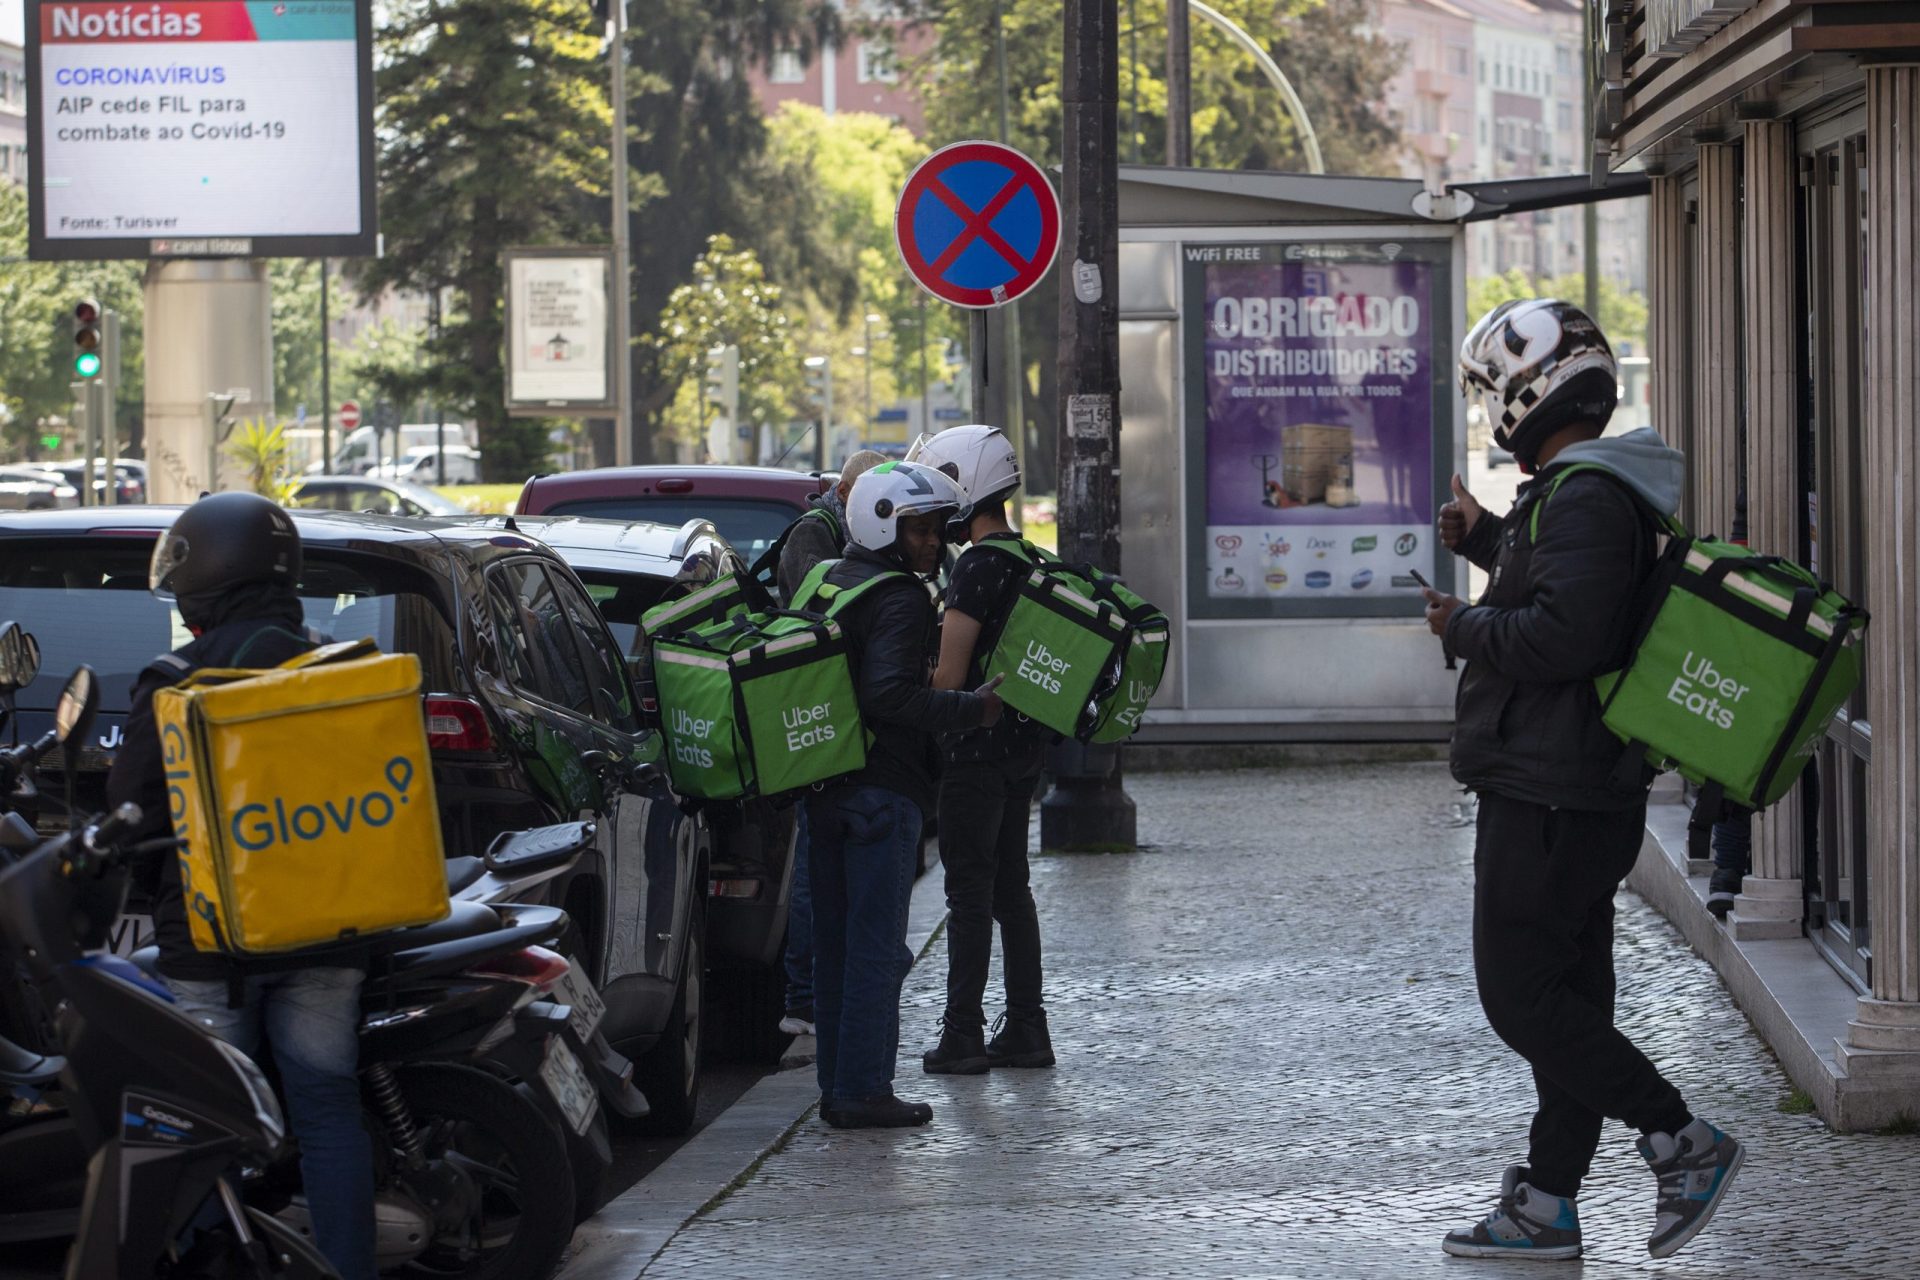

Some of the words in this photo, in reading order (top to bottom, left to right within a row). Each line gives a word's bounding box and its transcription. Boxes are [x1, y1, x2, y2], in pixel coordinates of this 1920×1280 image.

[52, 7, 202, 37] Notícias
[56, 63, 226, 85] CORONAVÍRUS
[57, 97, 94, 114] AIP
[101, 97, 150, 114] cede
[159, 96, 191, 113] FIL
[200, 98, 246, 115] para
[58, 123, 150, 141] combate
[158, 126, 183, 140] ao
[191, 121, 286, 140] Covid-19
[60, 217, 109, 230] Fonte:
[115, 215, 178, 229] Turisver
[1186, 248, 1221, 262] WiFi
[1226, 247, 1261, 261] FREE
[1214, 296, 1419, 338] OBRIGADO
[1215, 348, 1417, 376] DISTRIBUIDORES
[1232, 386, 1254, 398] QUE
[1256, 386, 1295, 397] ANDAM
[1299, 386, 1313, 397] NA
[1317, 386, 1339, 397] RUA
[1342, 386, 1364, 397] POR
[1367, 385, 1402, 397] TODOS
[1025, 640, 1072, 675] Uber
[1017, 659, 1061, 694] Eats
[1682, 651, 1750, 702] Uber
[783, 702, 831, 729] Uber
[1667, 677, 1735, 729] Eats
[671, 707, 714, 739] Uber
[786, 724, 836, 752] Eats
[673, 741, 714, 768] Eats
